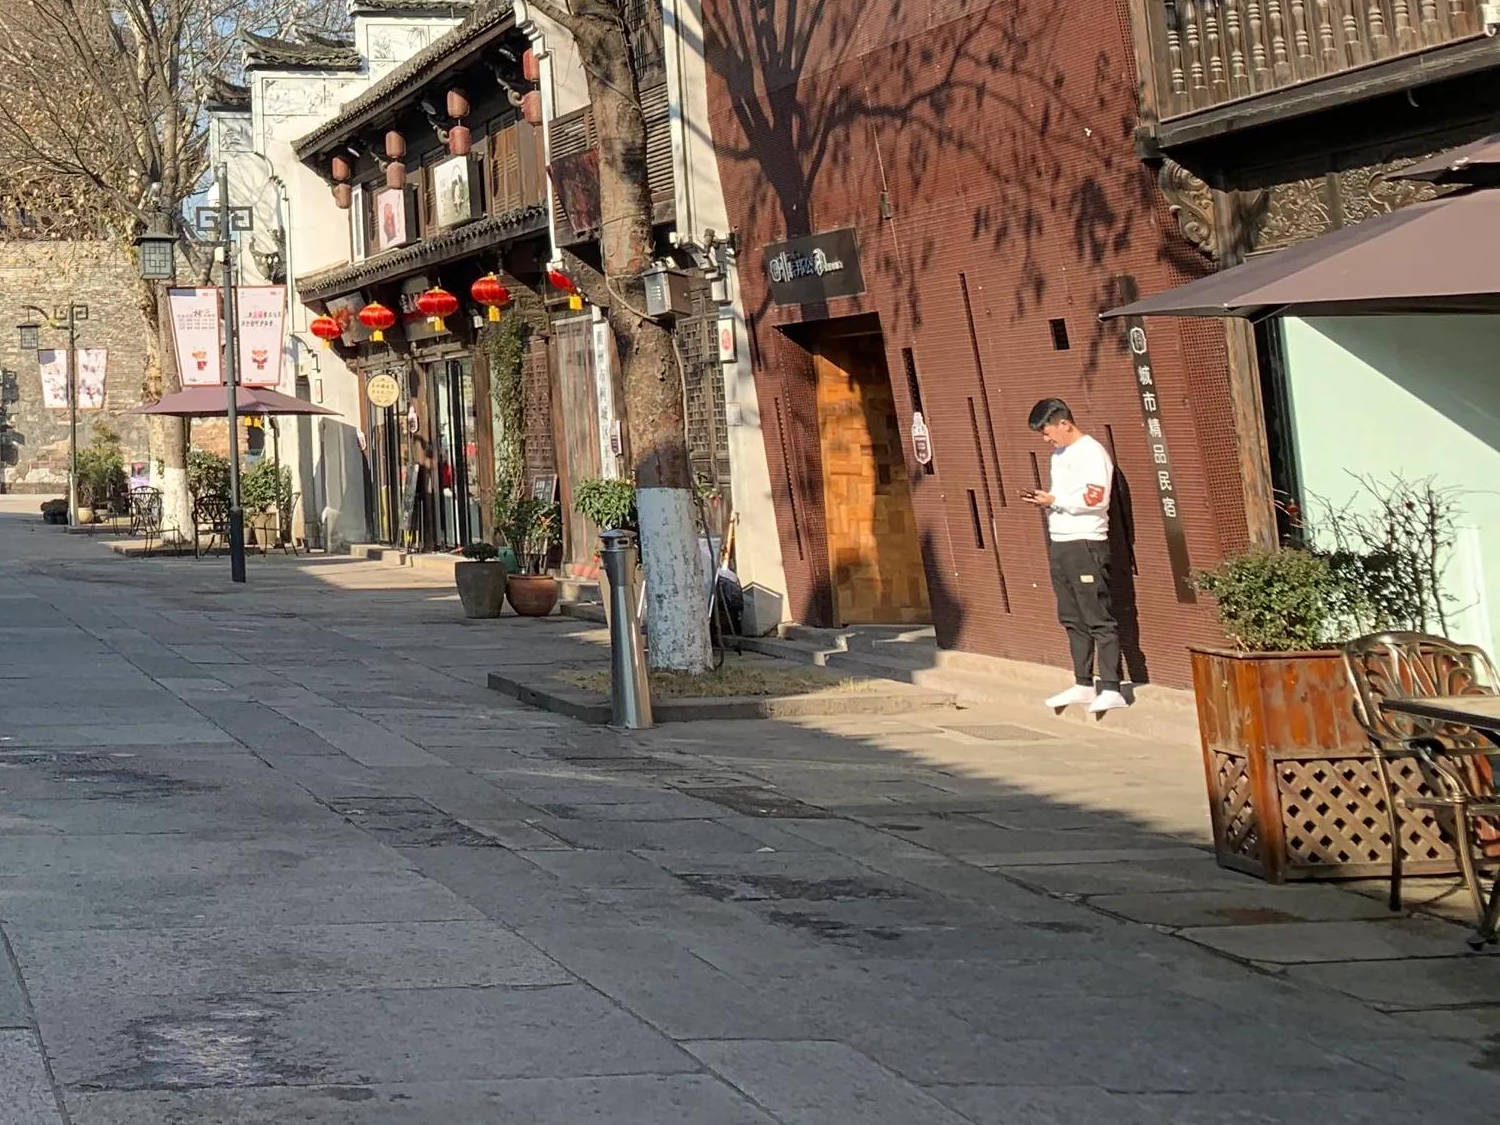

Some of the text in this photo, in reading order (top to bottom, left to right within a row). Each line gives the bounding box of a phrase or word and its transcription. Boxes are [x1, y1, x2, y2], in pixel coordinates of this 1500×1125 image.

[1137, 365, 1177, 518] 城市精品民宿
